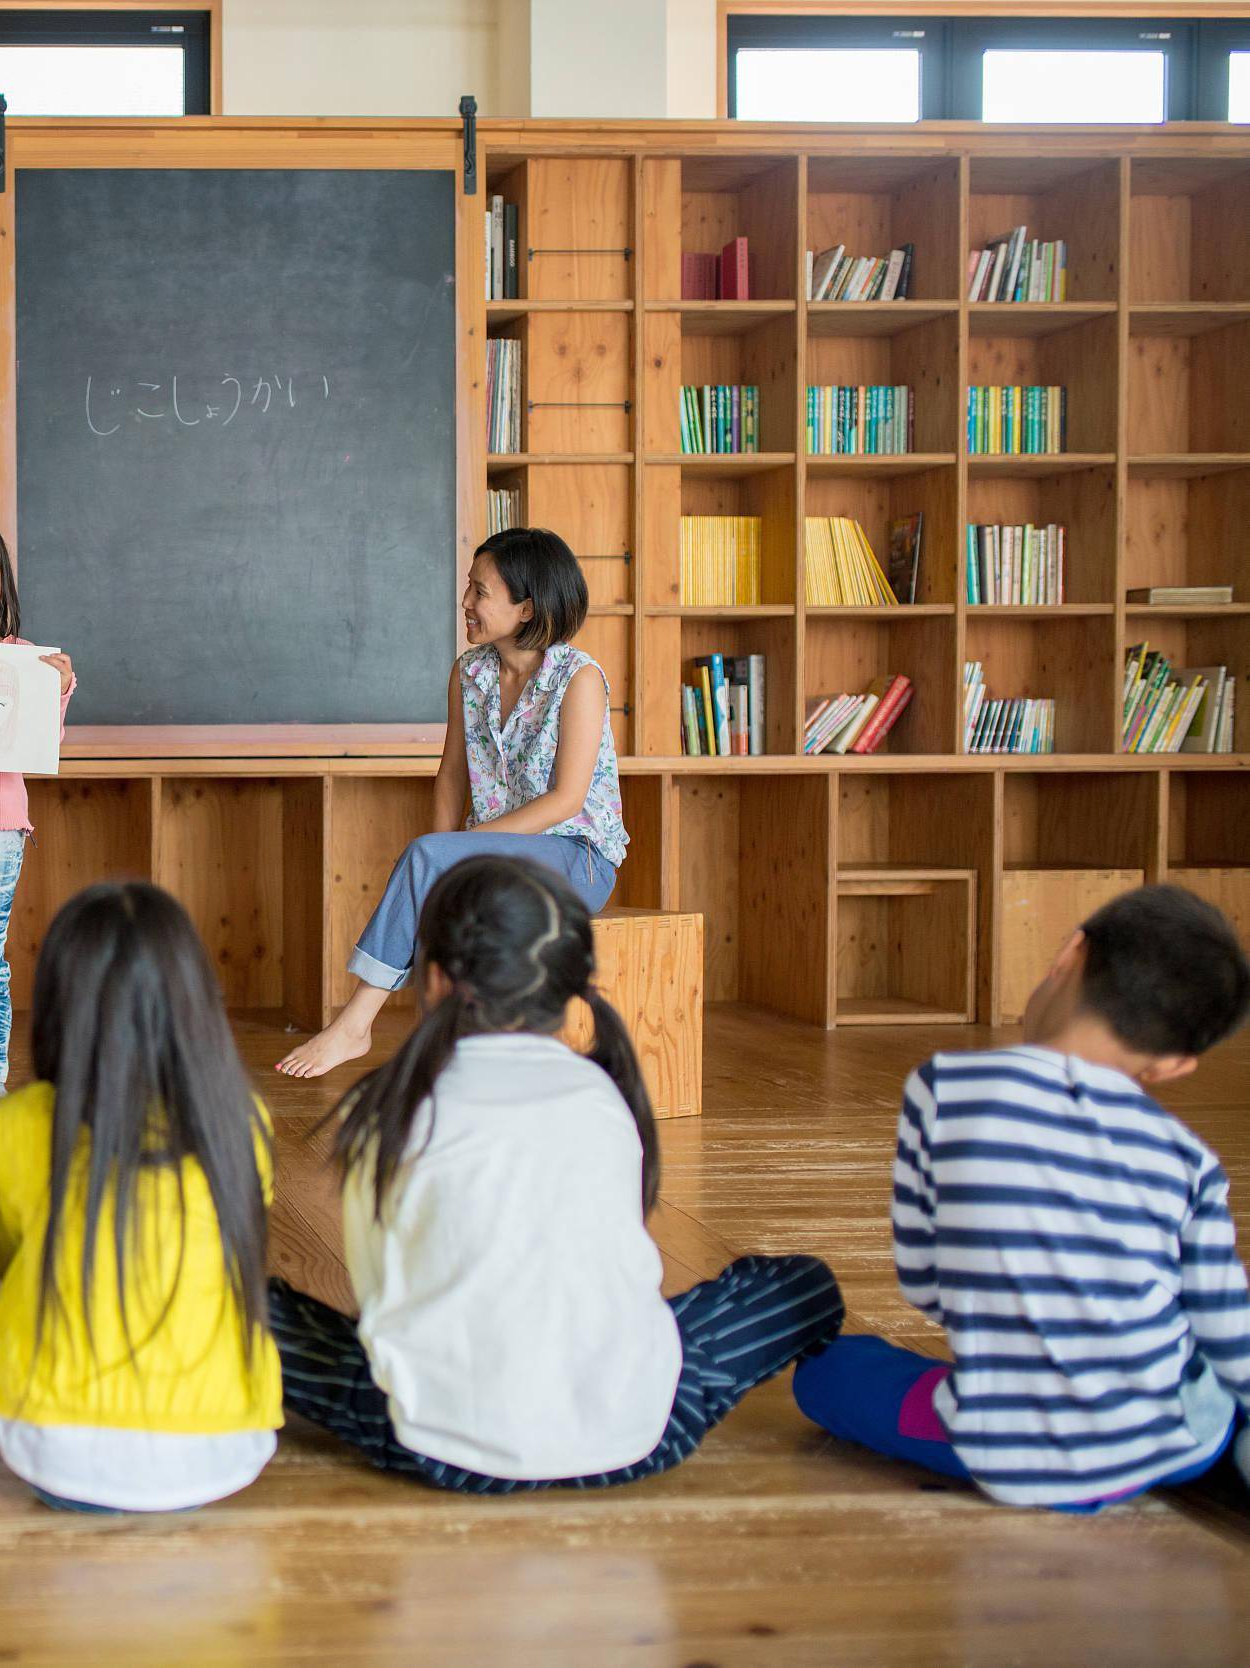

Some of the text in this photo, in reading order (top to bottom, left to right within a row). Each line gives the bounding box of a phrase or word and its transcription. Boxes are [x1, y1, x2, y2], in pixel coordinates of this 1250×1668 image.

[85, 373, 330, 436] じこしょうかい
